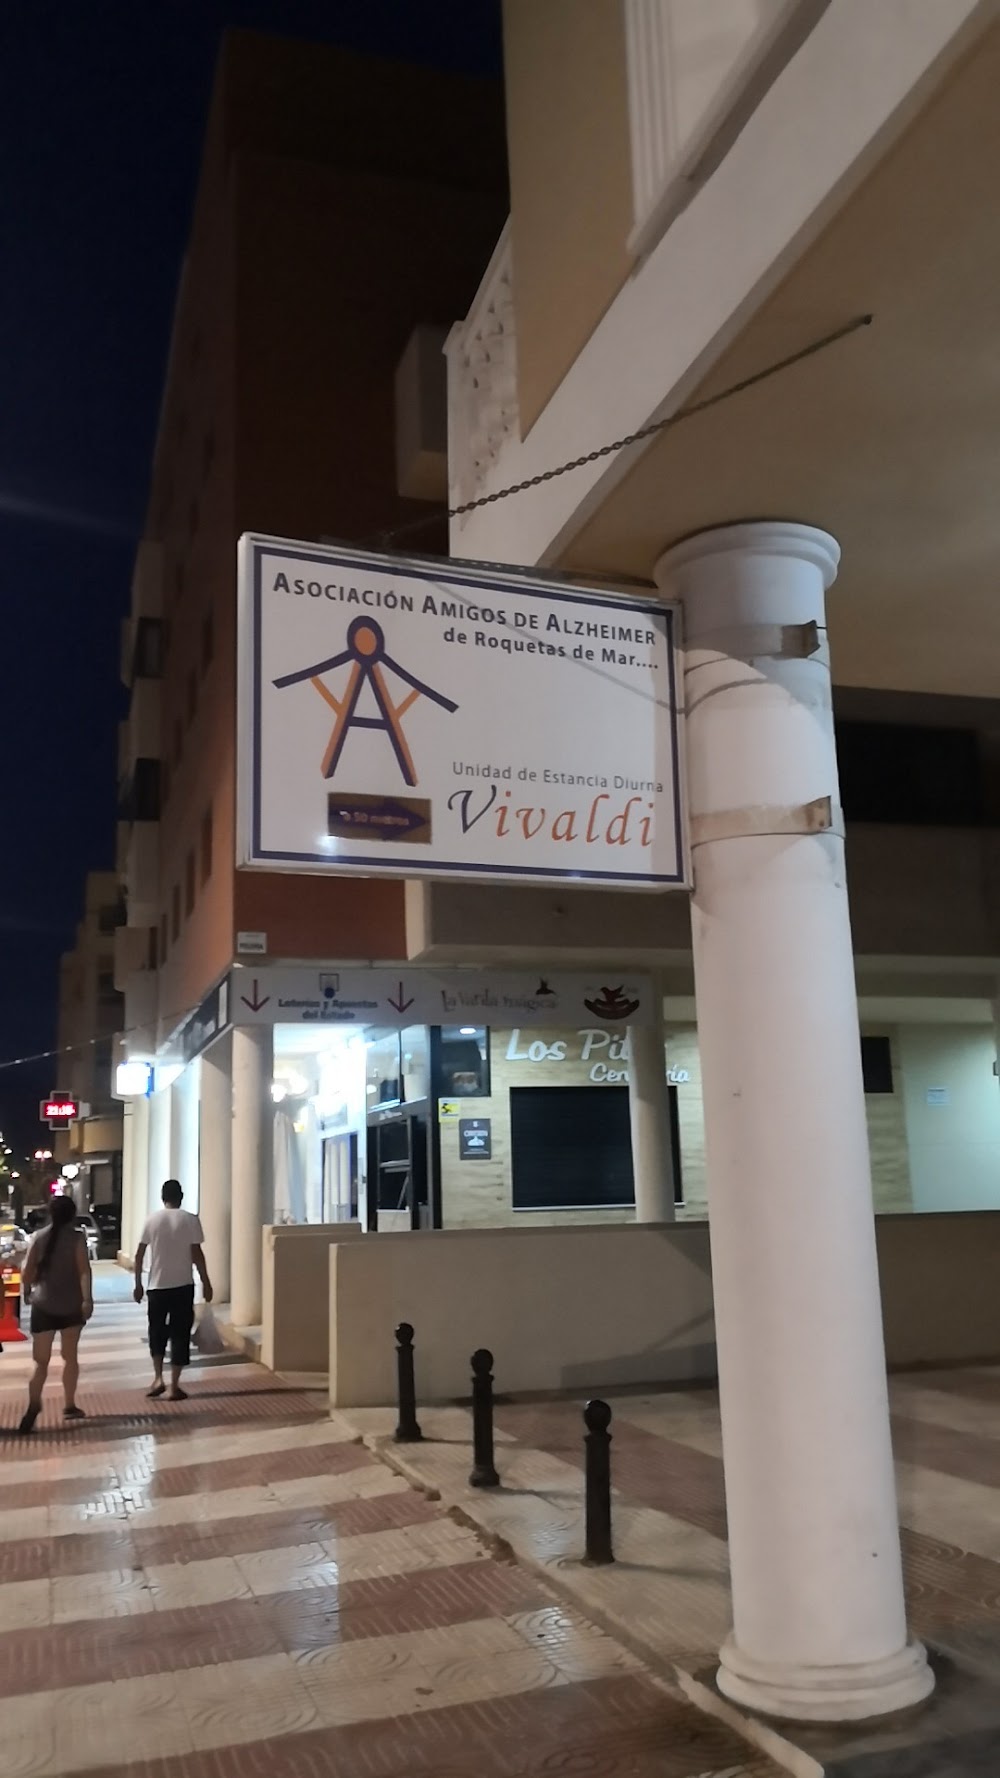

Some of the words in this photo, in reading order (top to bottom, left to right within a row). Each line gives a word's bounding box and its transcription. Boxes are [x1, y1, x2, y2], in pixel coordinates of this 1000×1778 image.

[273, 572, 413, 612] ASOCIACIÓN
[422, 595, 506, 625] AMIGOS
[514, 612, 539, 629] DE
[546, 613, 656, 645] ALZHEIMER
[443, 627, 467, 644] de
[475, 631, 566, 657] Roquetas
[573, 645, 594, 660] de
[453, 762, 511, 779] Unidad
[518, 768, 537, 782] de
[543, 769, 607, 788] Estancia
[614, 776, 663, 792] Diurna
[447, 784, 654, 847] Vivaldi
[505, 1029, 568, 1062] Los
